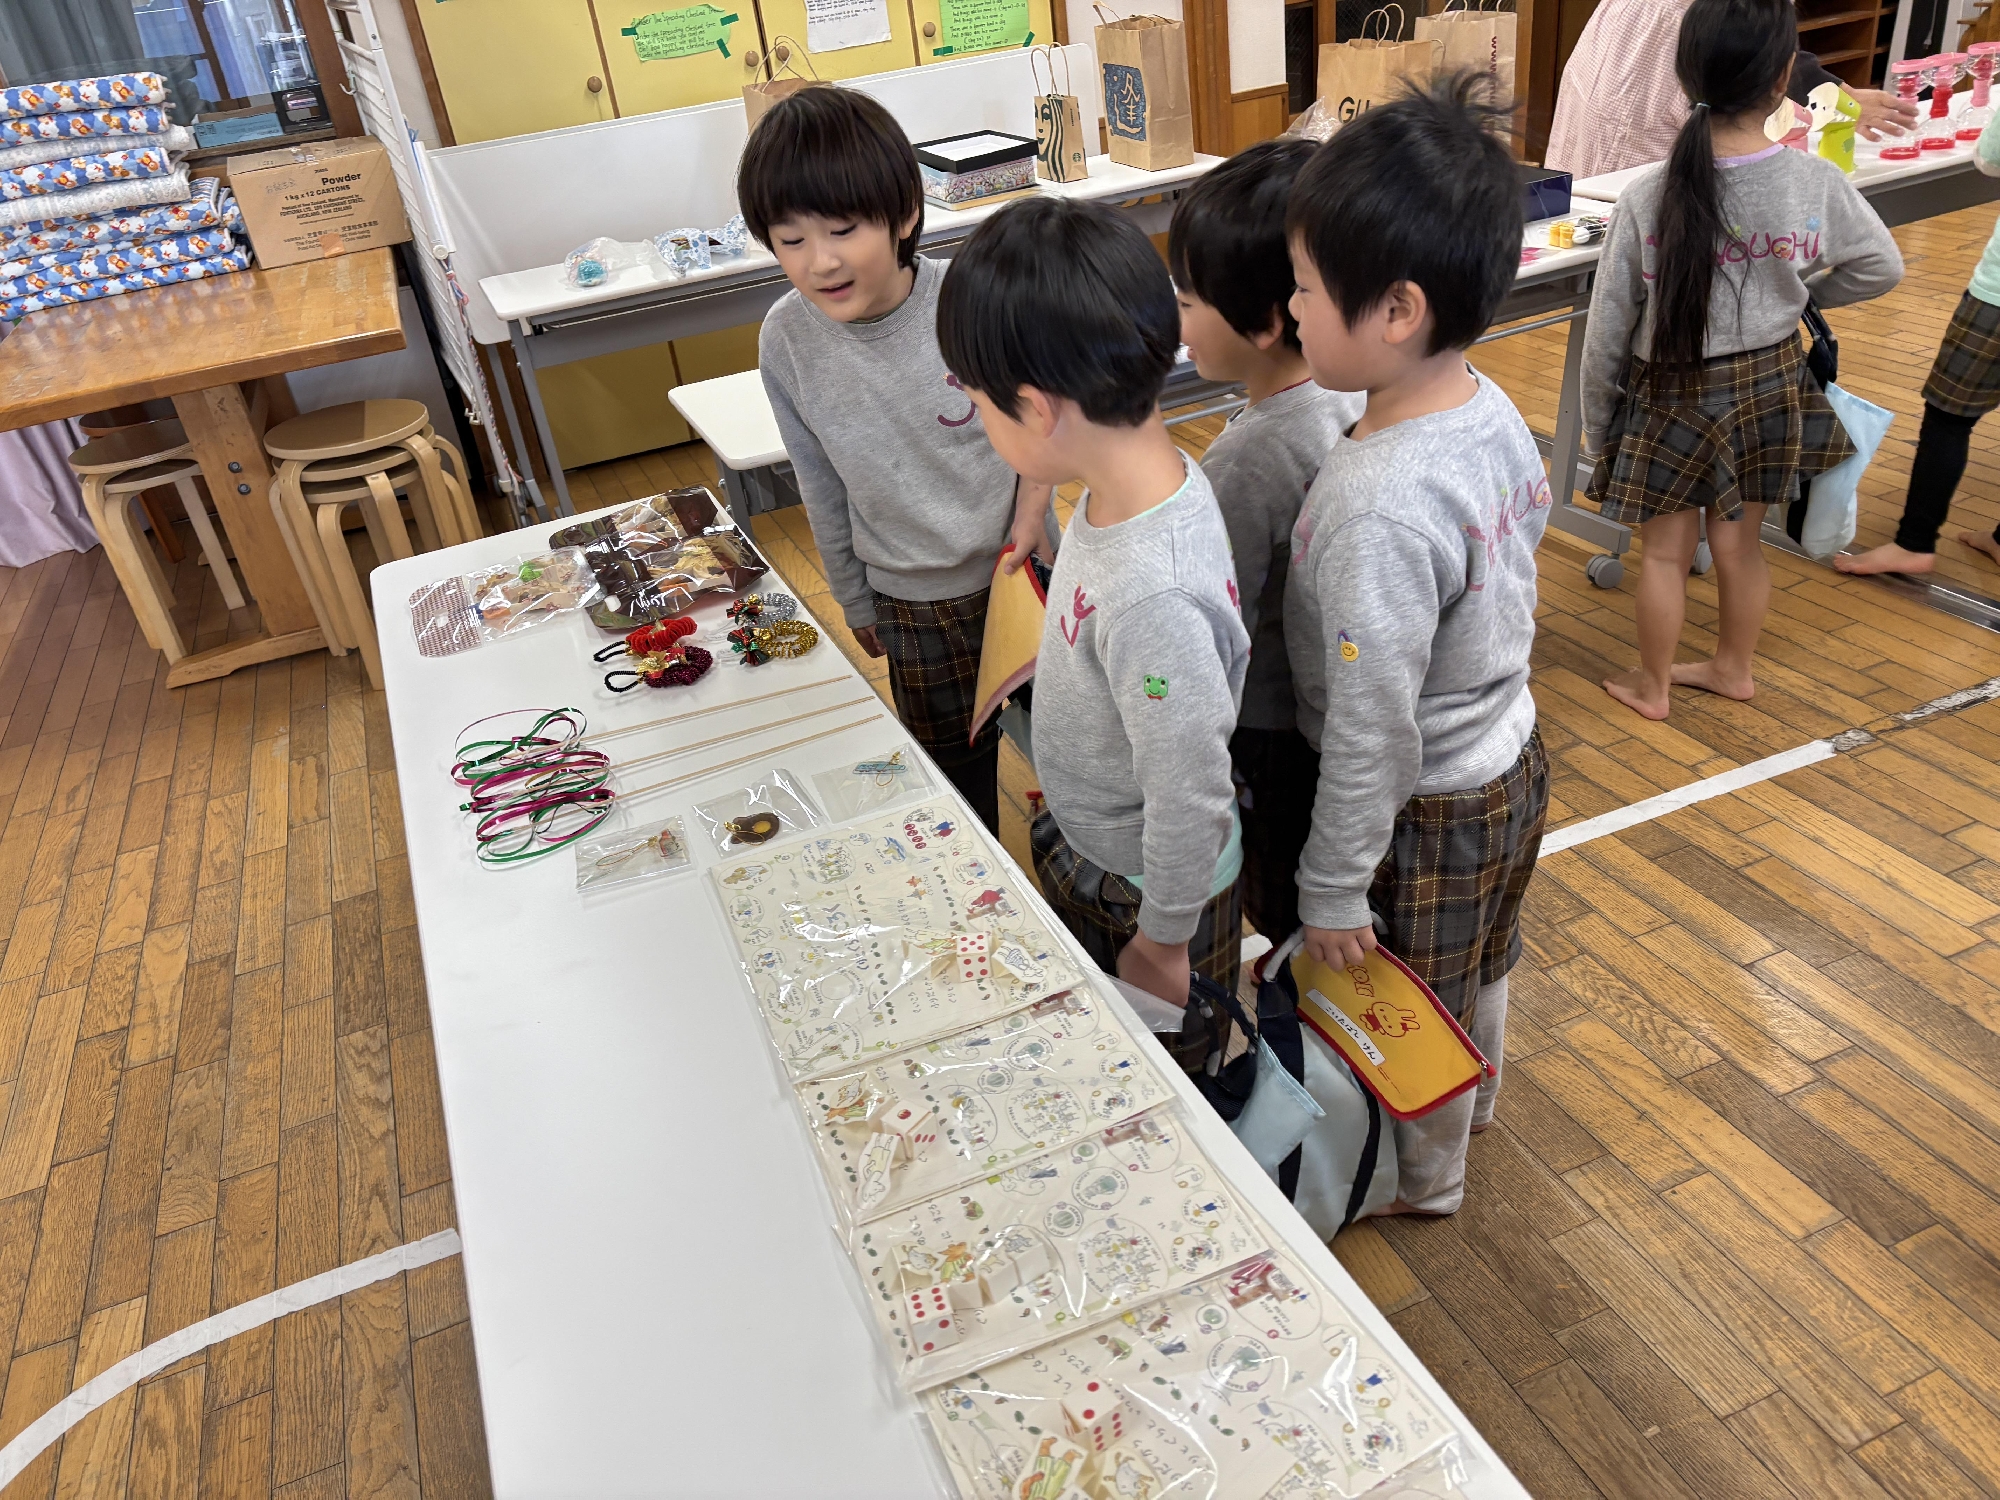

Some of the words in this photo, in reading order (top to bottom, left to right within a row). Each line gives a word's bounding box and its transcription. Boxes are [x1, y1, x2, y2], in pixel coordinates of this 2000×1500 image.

[321, 173, 361, 185] Powder
[289, 193, 299, 201] kg
[316, 184, 351, 195] CARTONS
[1362, 1042, 1376, 1060] けん
